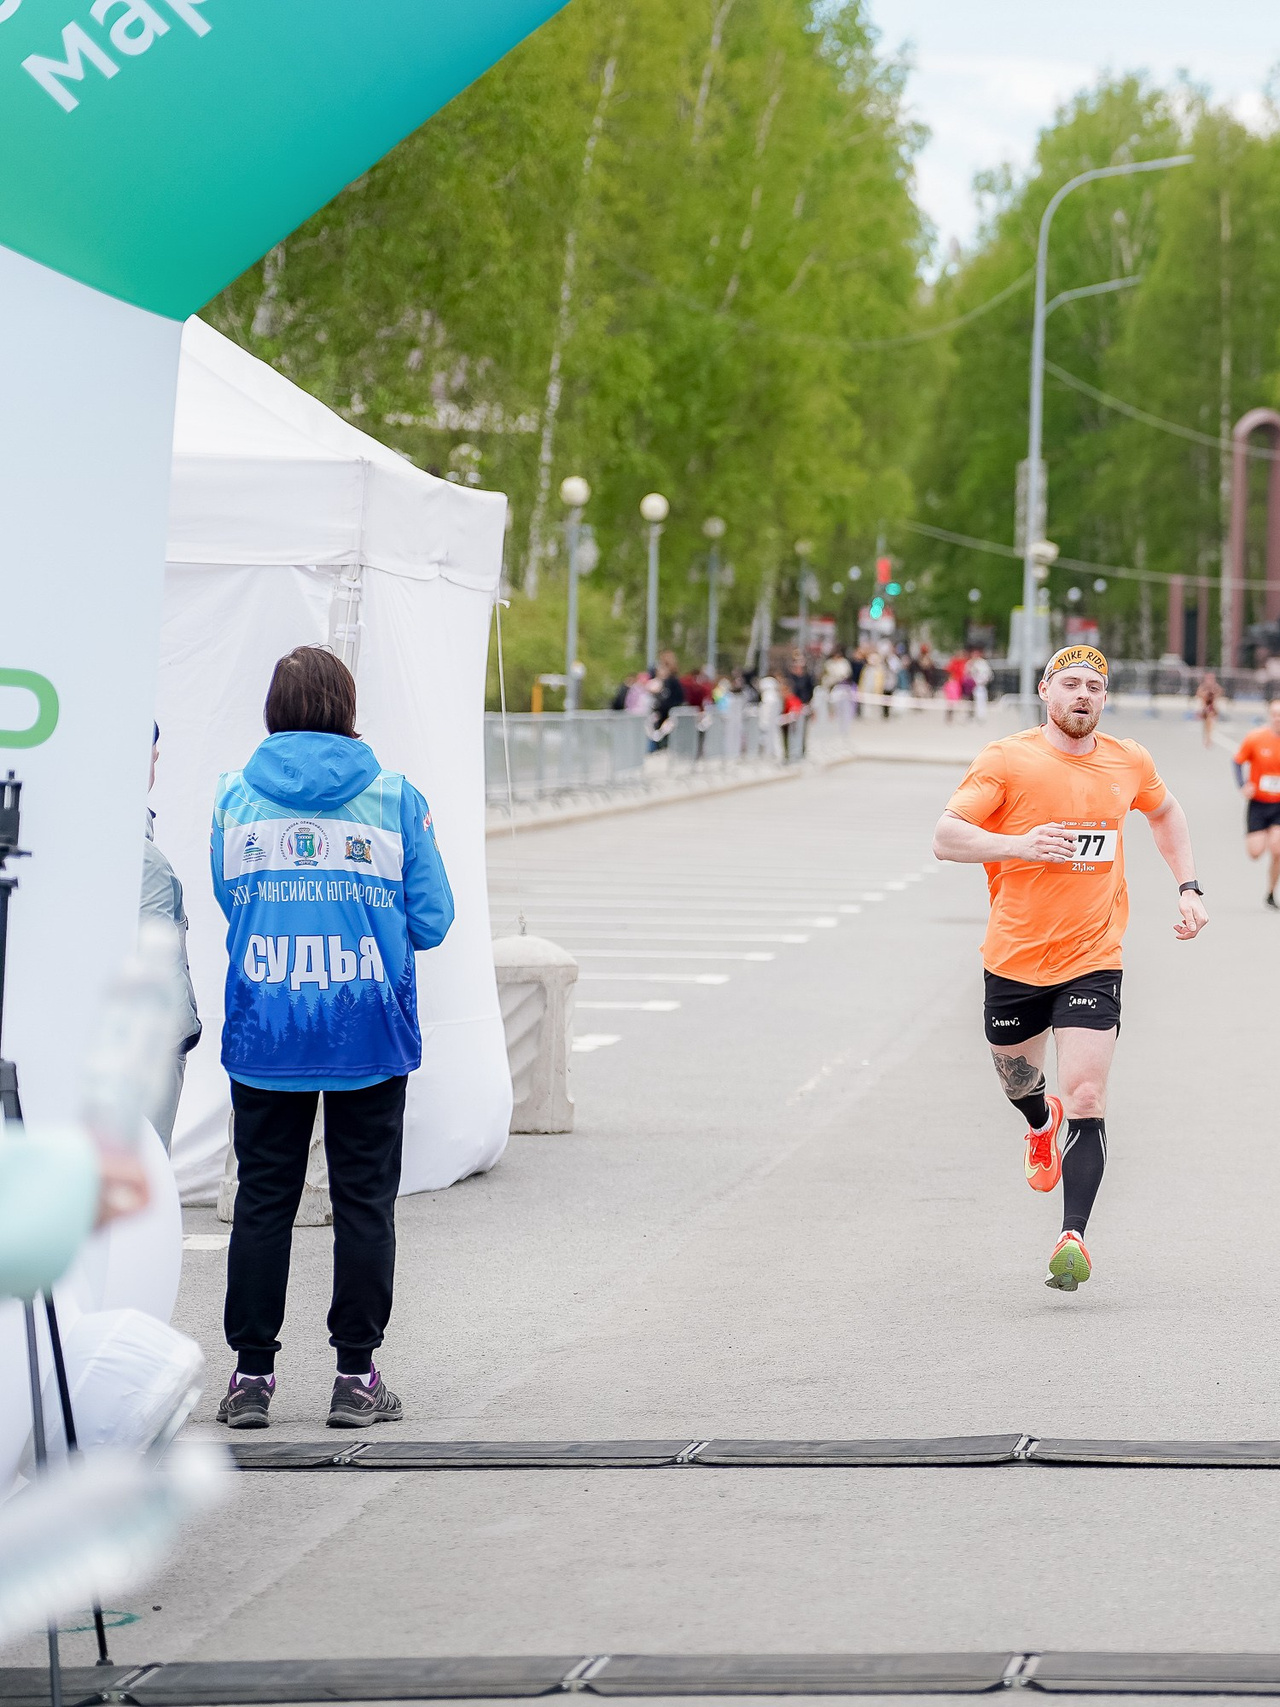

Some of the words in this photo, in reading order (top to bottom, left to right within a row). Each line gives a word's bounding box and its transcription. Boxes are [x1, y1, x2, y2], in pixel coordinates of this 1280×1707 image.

[1086, 651, 1106, 670] RIDE
[1063, 834, 1105, 857] 77
[326, 881, 360, 904] ЮГРА
[243, 933, 385, 990] СУДЬЯ
[1070, 997, 1095, 1007] ASRV
[994, 1018, 1017, 1027] ASRV
